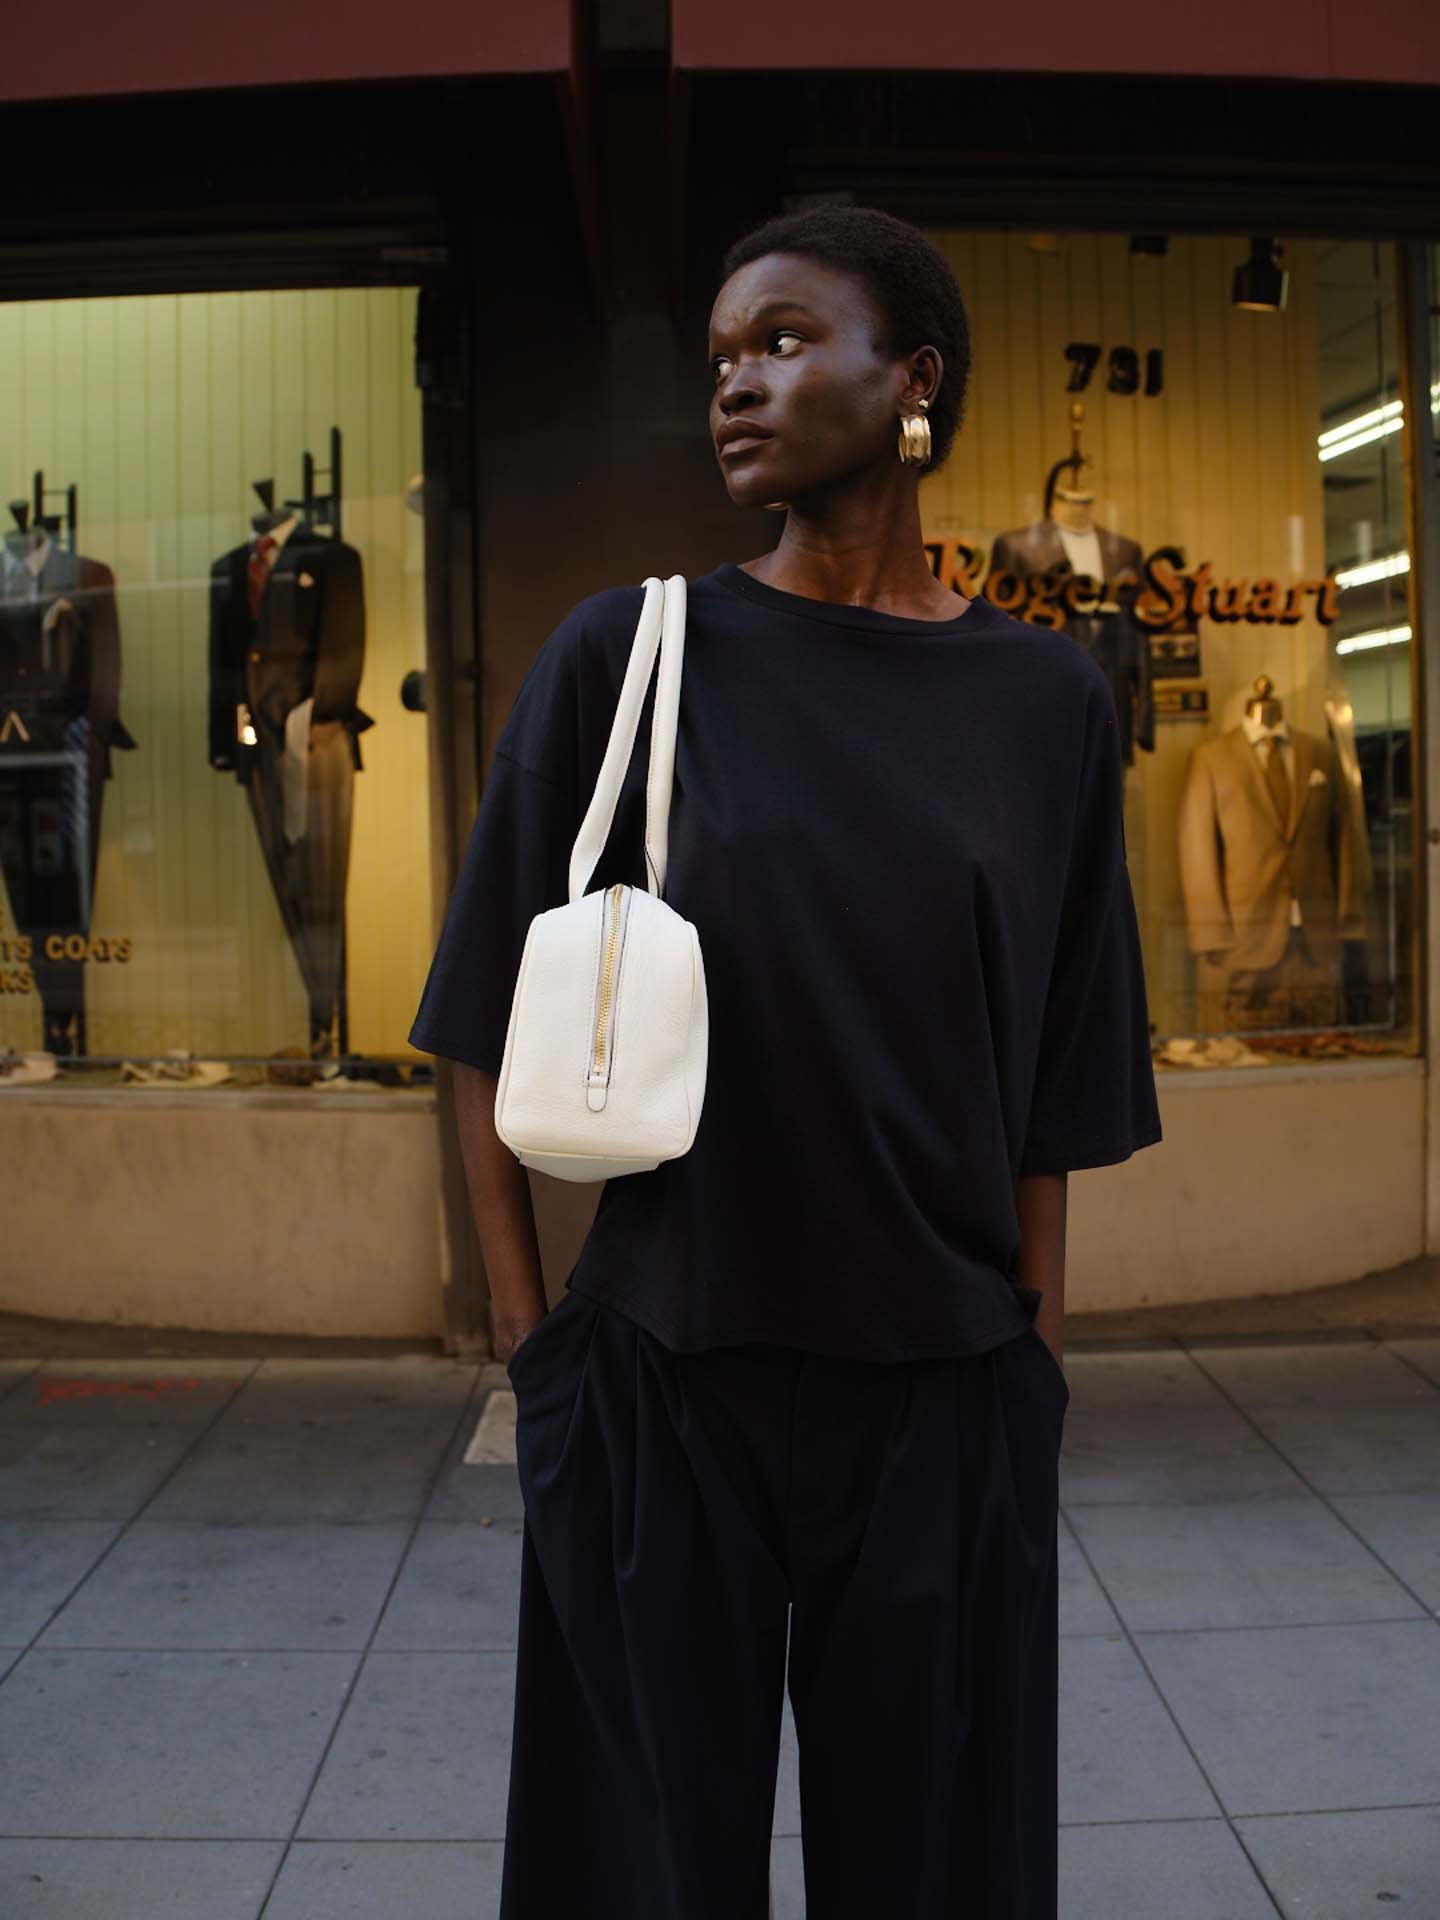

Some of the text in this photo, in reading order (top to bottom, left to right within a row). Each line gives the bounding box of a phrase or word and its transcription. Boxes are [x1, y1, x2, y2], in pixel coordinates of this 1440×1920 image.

[923, 539, 1340, 633] Roger Stuart
[45, 934, 133, 964] COATS
